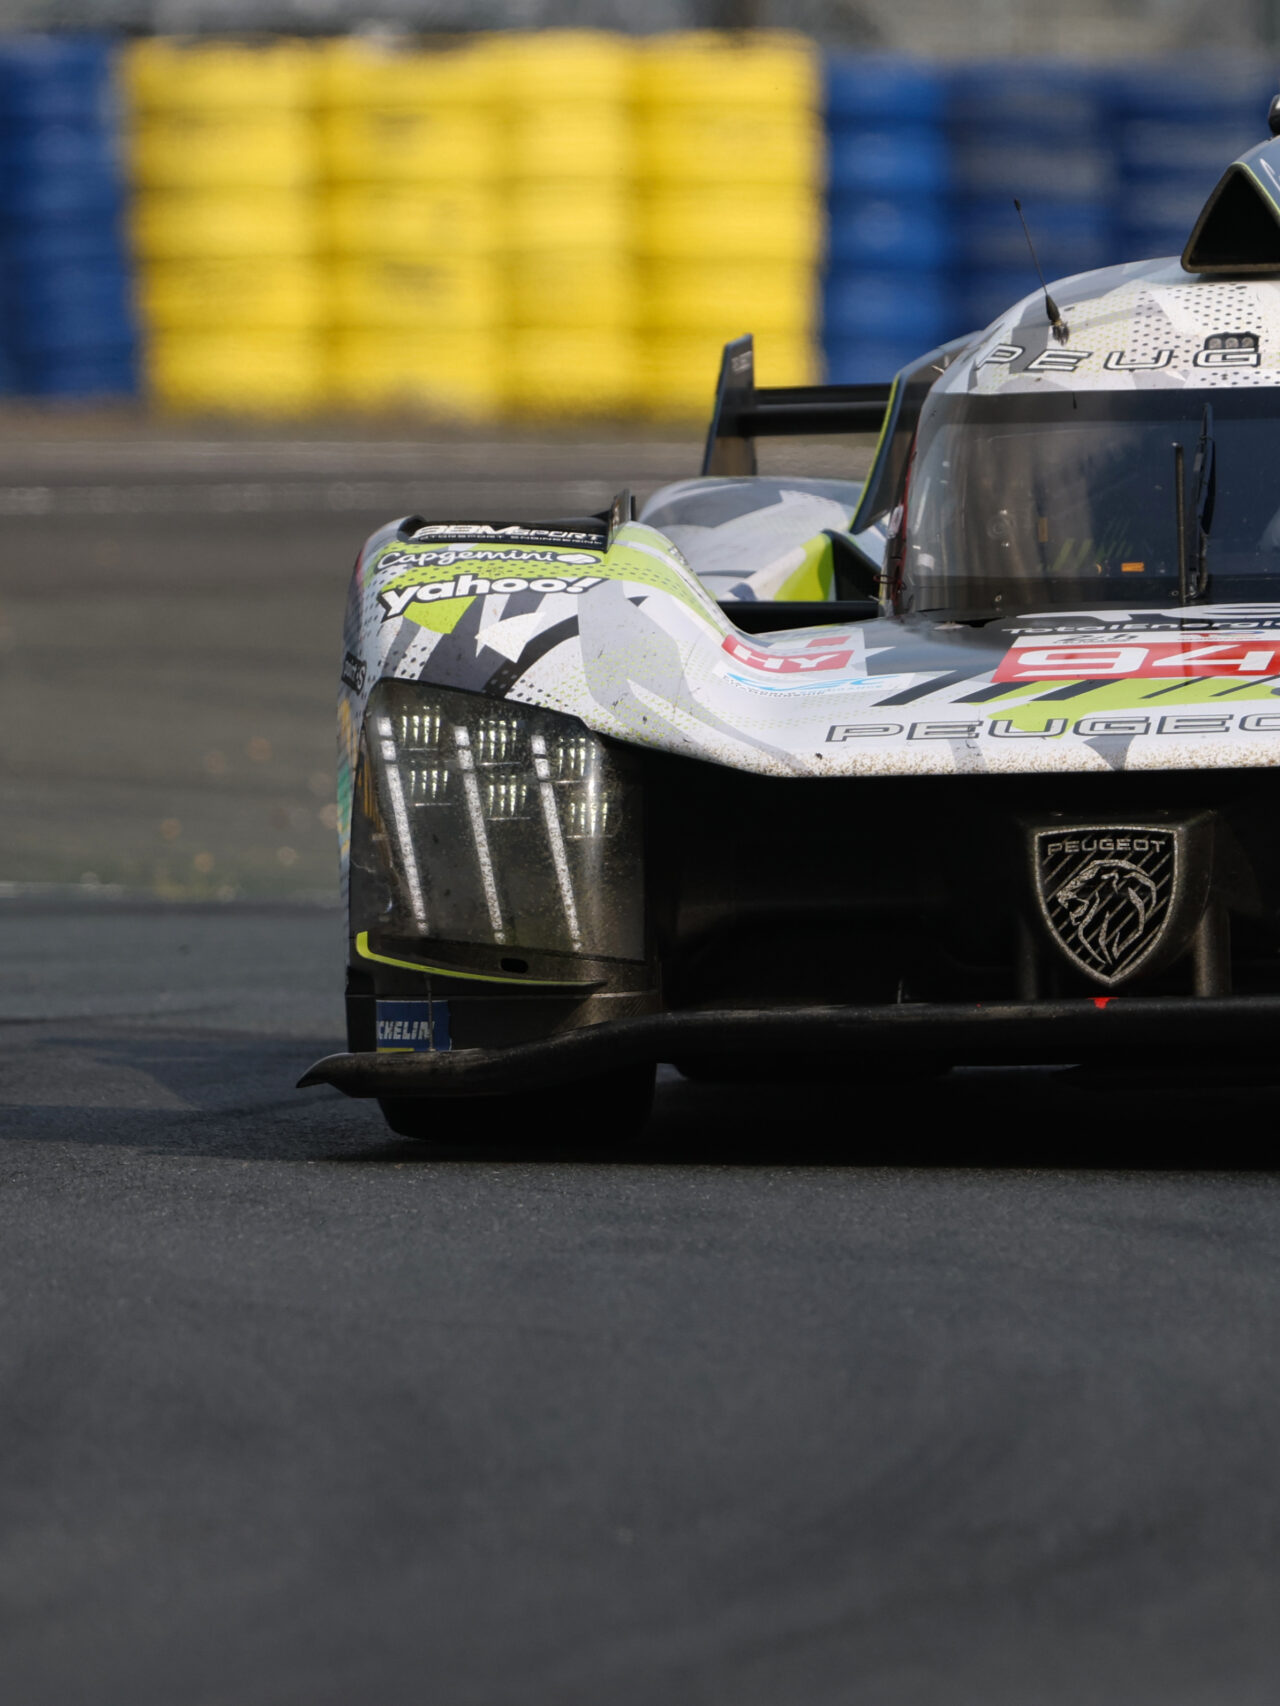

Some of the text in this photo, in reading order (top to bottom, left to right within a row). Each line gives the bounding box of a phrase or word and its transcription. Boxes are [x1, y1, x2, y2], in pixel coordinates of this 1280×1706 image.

[377, 550, 553, 569] Capgemini
[381, 574, 602, 617] yahoo!
[733, 644, 842, 670] HY
[1013, 644, 1276, 678] 94
[1047, 838, 1166, 855] PEUGEOT
[376, 1020, 436, 1040] CHELIN
